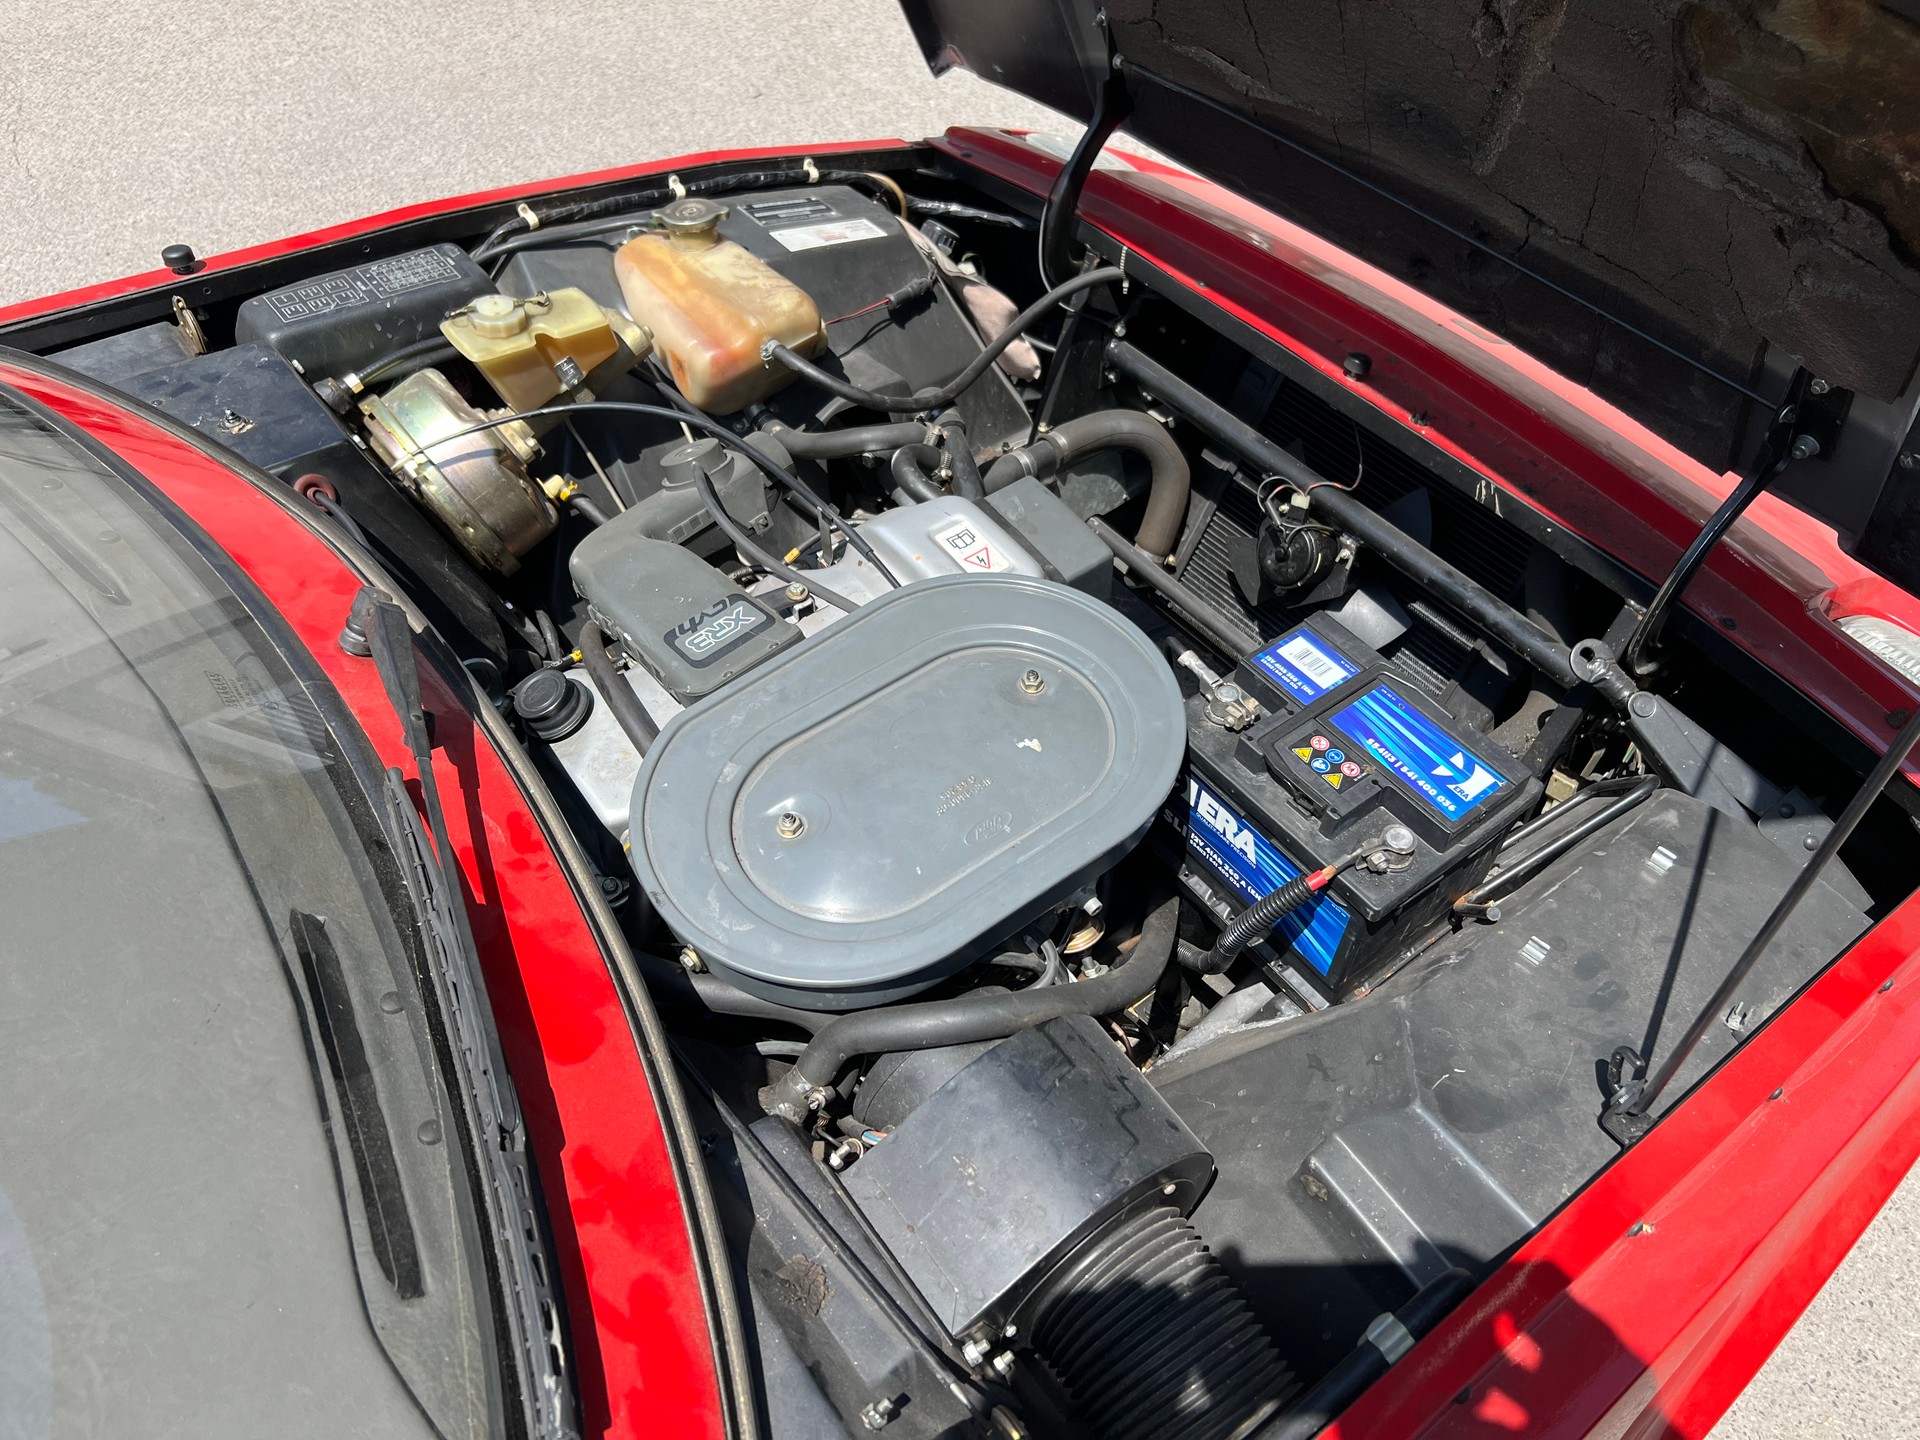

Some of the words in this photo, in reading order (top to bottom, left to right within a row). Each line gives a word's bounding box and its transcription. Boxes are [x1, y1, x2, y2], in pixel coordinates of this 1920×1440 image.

[685, 606, 756, 652] XR3
[1265, 654, 1275, 664] 12V
[1286, 672, 1298, 683] 360
[1366, 738, 1393, 763] S54113
[1400, 766, 1417, 780] 541
[1416, 780, 1436, 795] 400
[1437, 795, 1456, 812] 036
[1453, 785, 1469, 799] ERA
[1162, 808, 1186, 837] SLI
[1196, 812, 1216, 831] QUALITY
[1216, 831, 1230, 845] CARE
[1230, 843, 1256, 869] PRECISION
[1197, 790, 1256, 865] ERA
[1189, 839, 1206, 856] S54113
[1208, 856, 1218, 867] 541
[1217, 866, 1229, 878] 400
[1228, 876, 1239, 888] 036
[1190, 832, 1205, 846] 12V
[1204, 847, 1223, 866] 41Ah
[1223, 863, 1239, 880] 360
[1239, 879, 1246, 888] A
